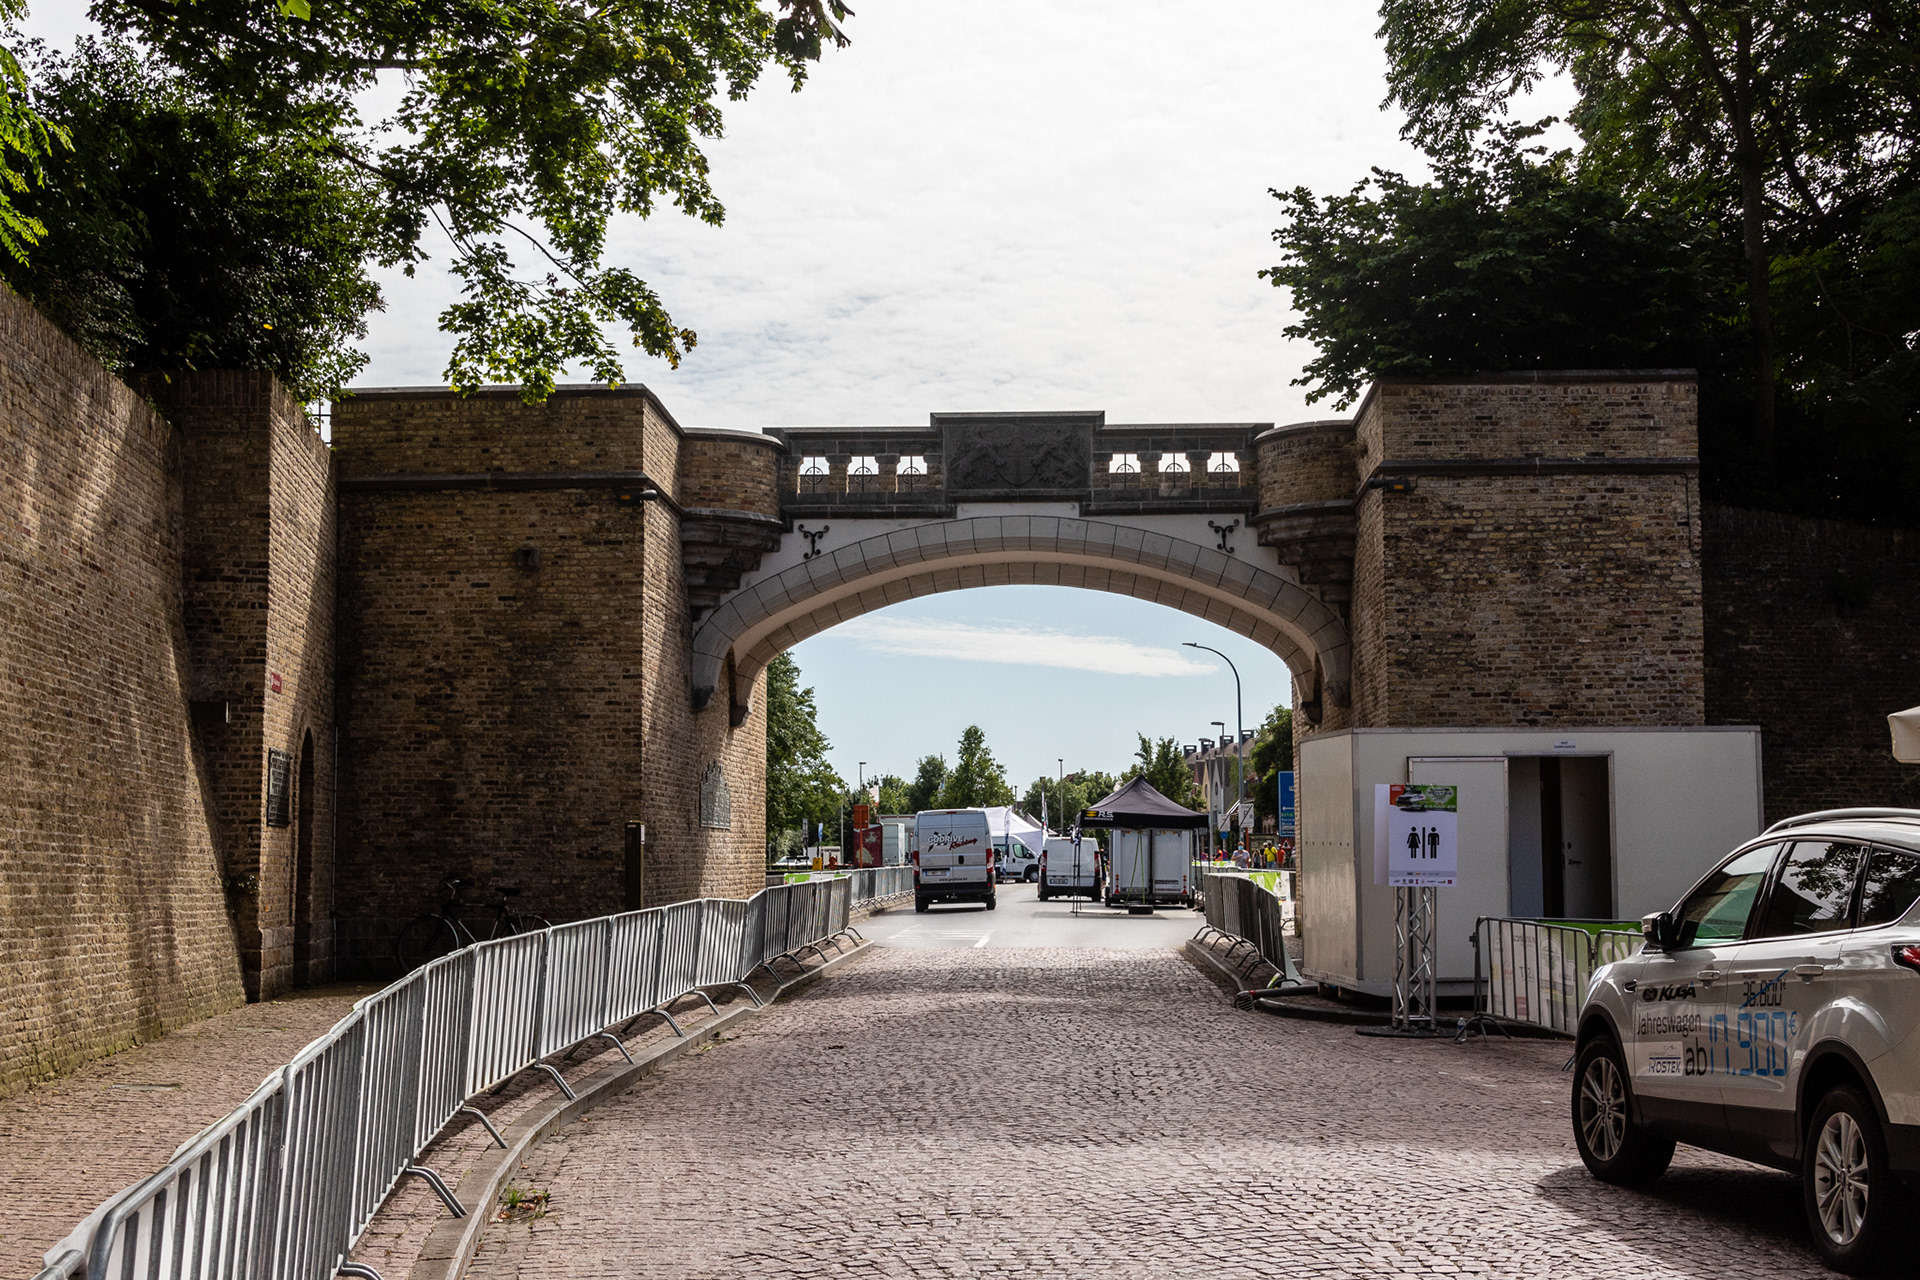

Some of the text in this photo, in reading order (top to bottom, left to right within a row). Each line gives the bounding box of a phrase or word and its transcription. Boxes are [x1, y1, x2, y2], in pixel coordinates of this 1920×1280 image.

[927, 834, 964, 844] GODRIVE
[948, 838, 979, 851] Racing
[1658, 982, 1697, 1002] KUGA
[1637, 1012, 1702, 1038] Jahreswagen
[1648, 1057, 1681, 1074] ROSTEK
[1685, 1037, 1707, 1076] ab
